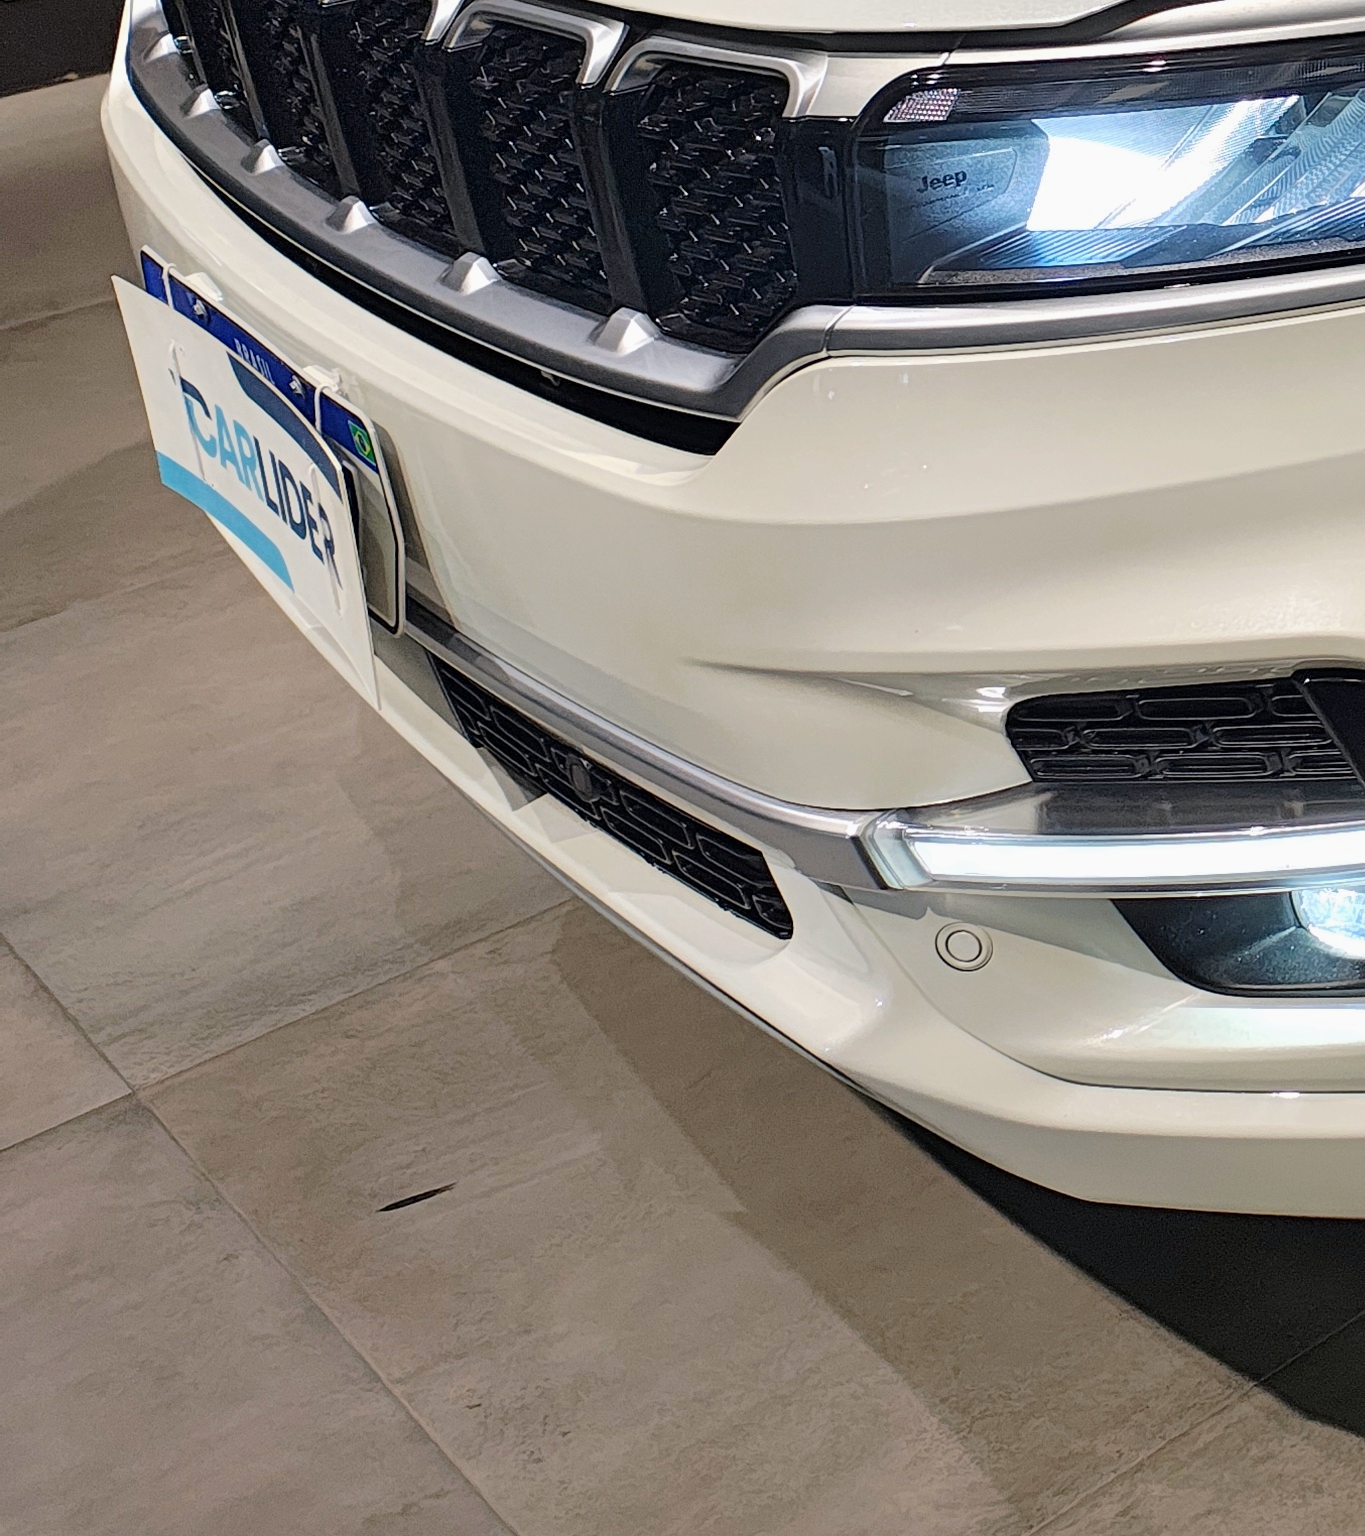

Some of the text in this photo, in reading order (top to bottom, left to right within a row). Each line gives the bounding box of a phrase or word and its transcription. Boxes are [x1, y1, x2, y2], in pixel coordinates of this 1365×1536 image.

[916, 170, 967, 194] Jeep
[233, 337, 276, 386] BRASIL
[179, 375, 343, 590] CARLIDER
